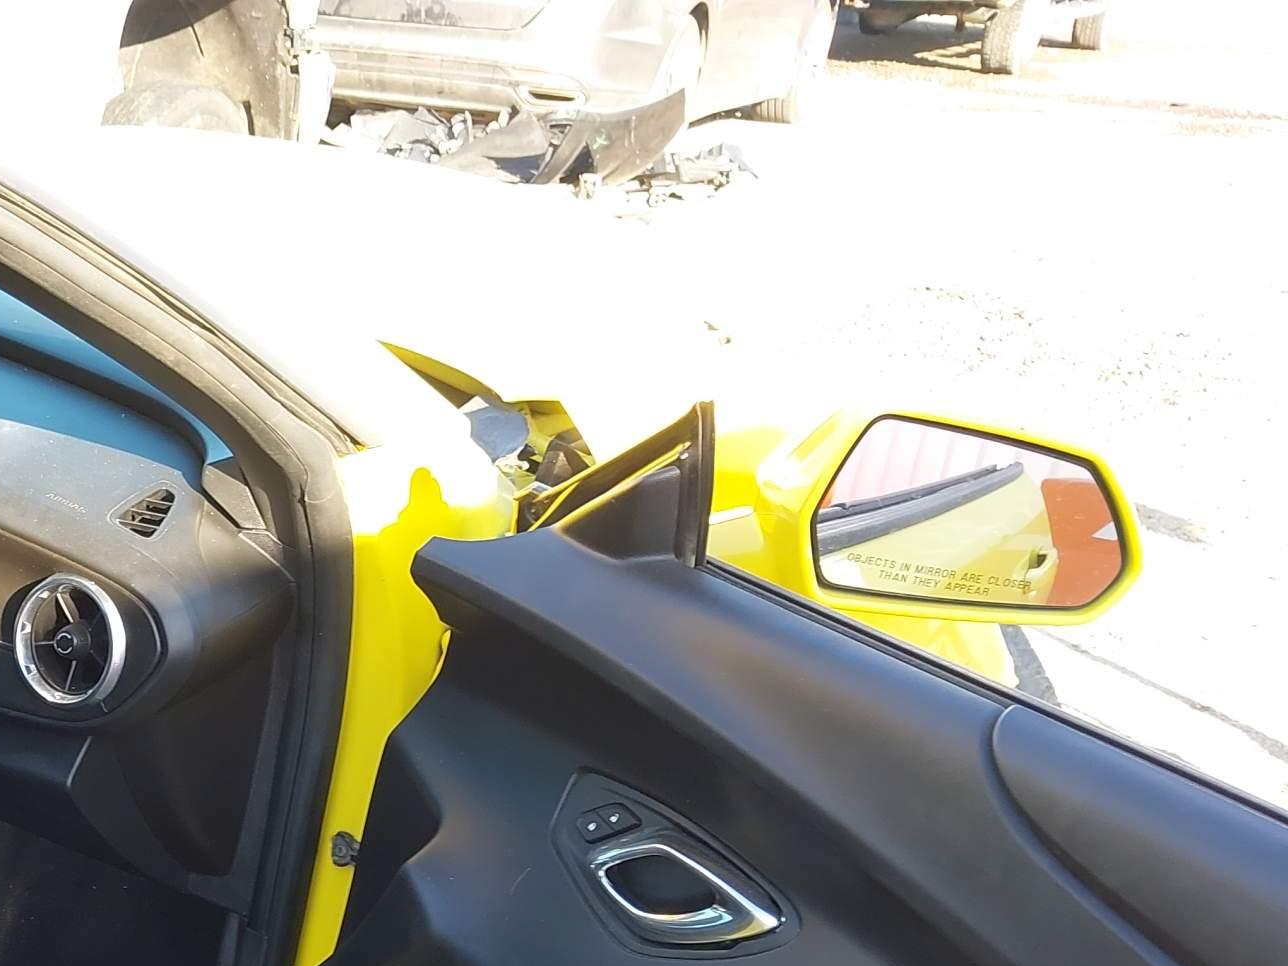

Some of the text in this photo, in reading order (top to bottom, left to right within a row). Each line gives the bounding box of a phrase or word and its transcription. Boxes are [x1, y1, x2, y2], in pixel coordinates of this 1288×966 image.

[847, 552, 1032, 591] OBJECTS IN MIRROR ARE CLOSER
[879, 569, 990, 596] THAN THEY APPEAR
